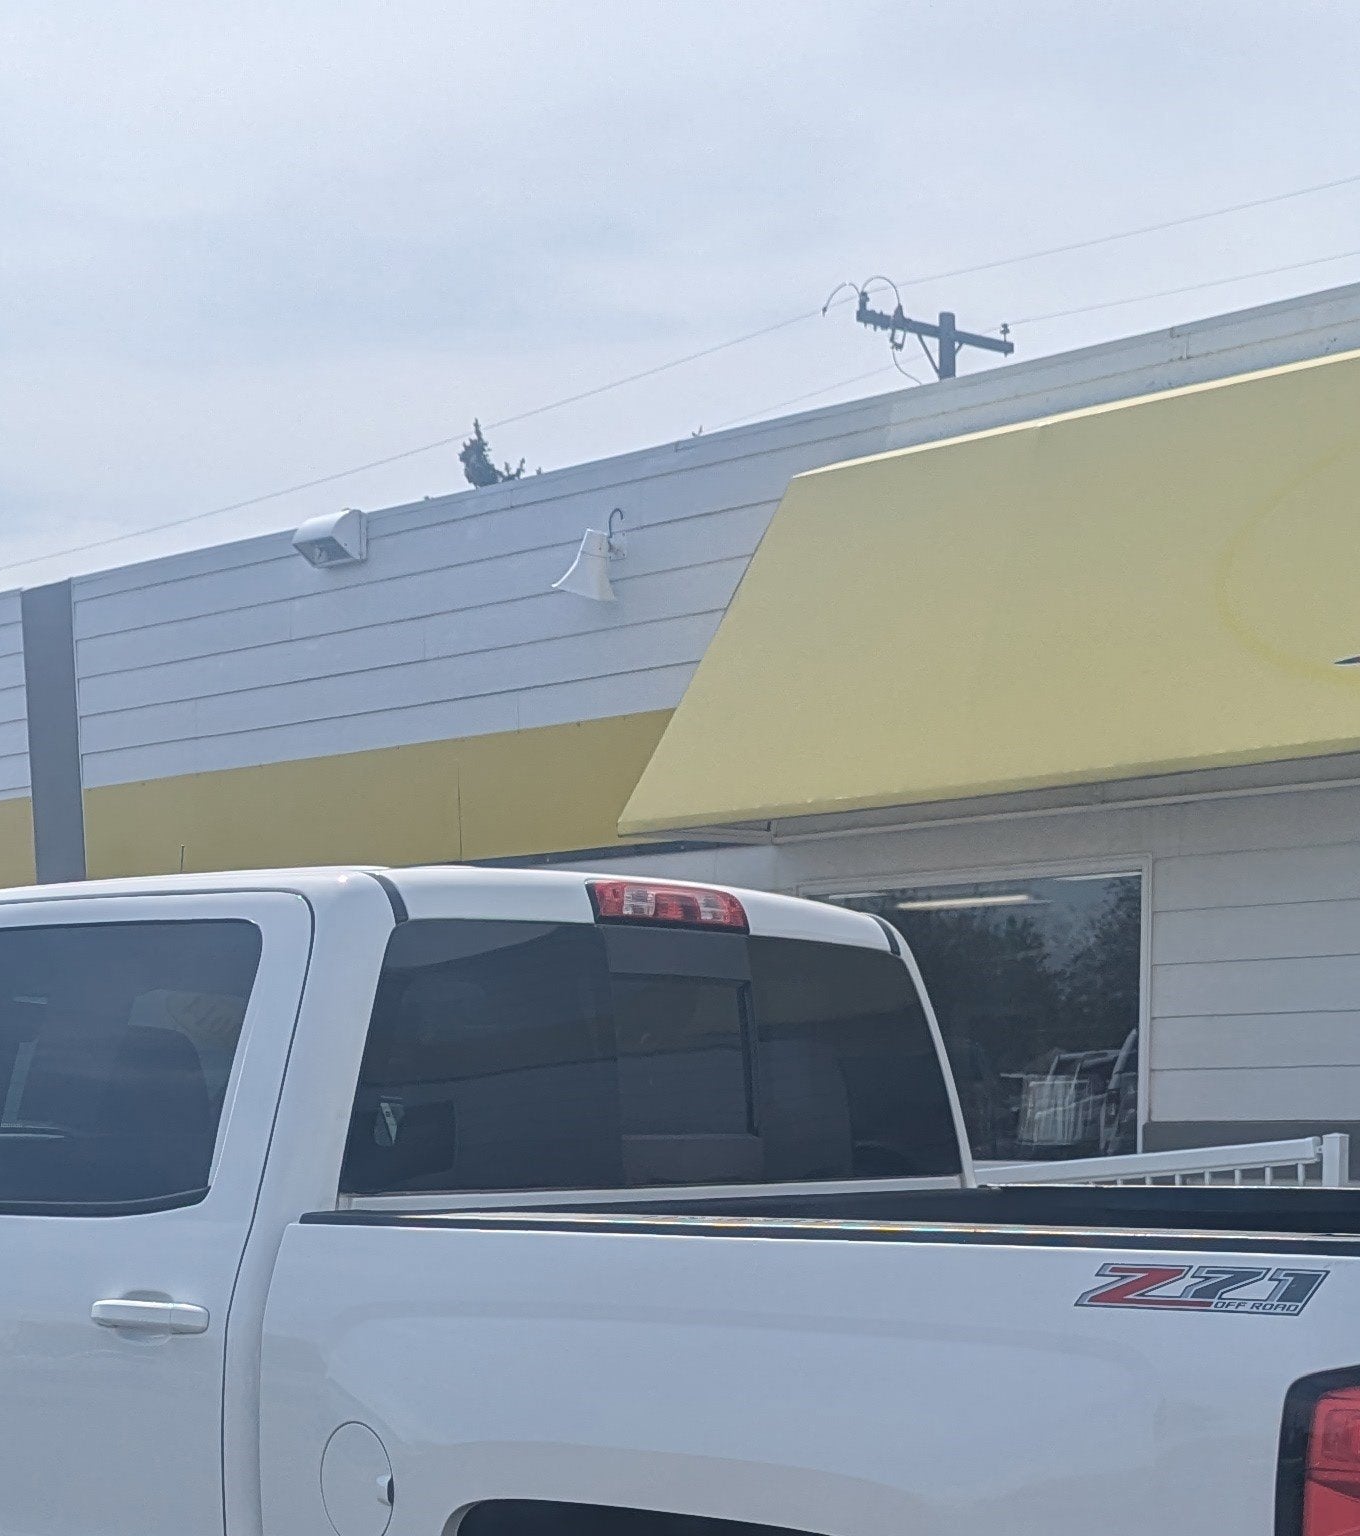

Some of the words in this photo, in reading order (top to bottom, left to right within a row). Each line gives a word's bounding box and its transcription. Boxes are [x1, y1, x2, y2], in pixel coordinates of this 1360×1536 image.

[1074, 1262, 1331, 1316] Z71
[1214, 1301, 1247, 1309] OFF
[1250, 1302, 1300, 1312] ROAD
